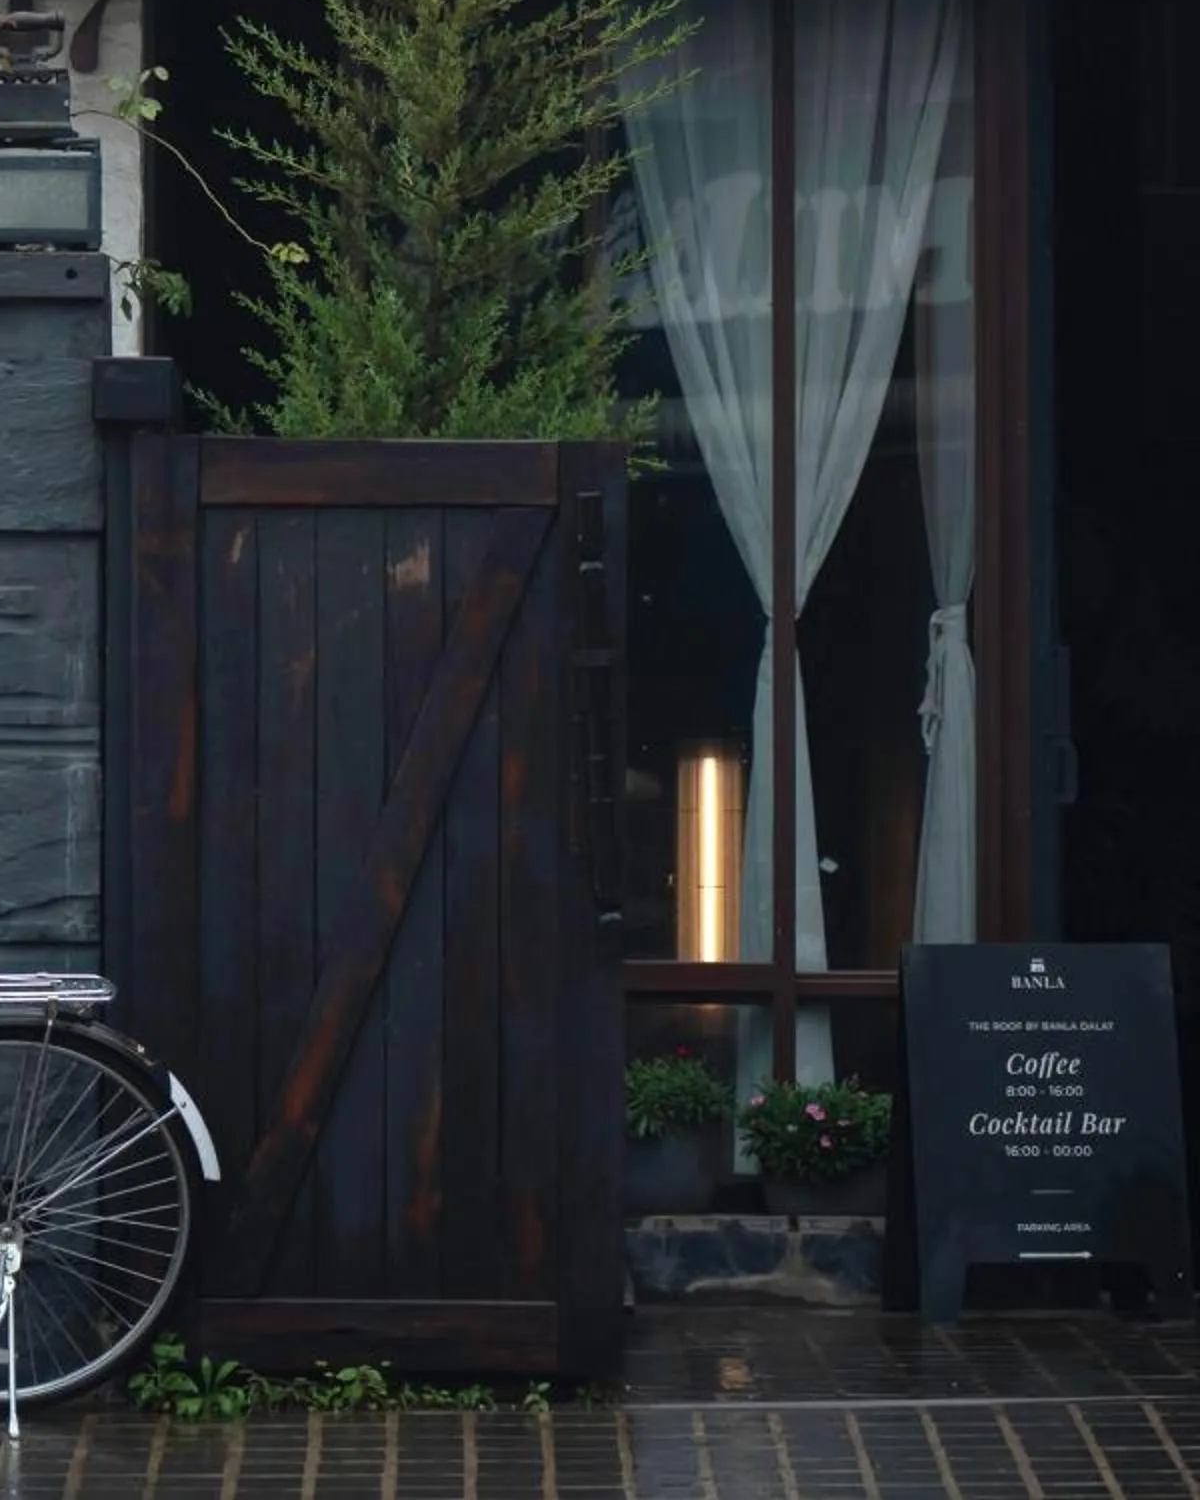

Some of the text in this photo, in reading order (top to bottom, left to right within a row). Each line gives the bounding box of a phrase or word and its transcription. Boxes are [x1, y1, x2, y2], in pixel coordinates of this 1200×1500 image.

[1010, 975, 1066, 990] BANLA
[968, 1021, 990, 1031] THE
[1025, 1021, 1039, 1031] BY
[1041, 1021, 1078, 1031] BANLA
[1006, 1051, 1082, 1079] Coffee
[1005, 1084, 1037, 1098] 8:00
[1049, 1084, 1085, 1098] 16:00
[968, 1110, 1127, 1136] Cocktail Bar
[1004, 1144, 1041, 1158] 16:00
[1052, 1144, 1094, 1158] 00:00
[1016, 1223, 1061, 1233] PARKING
